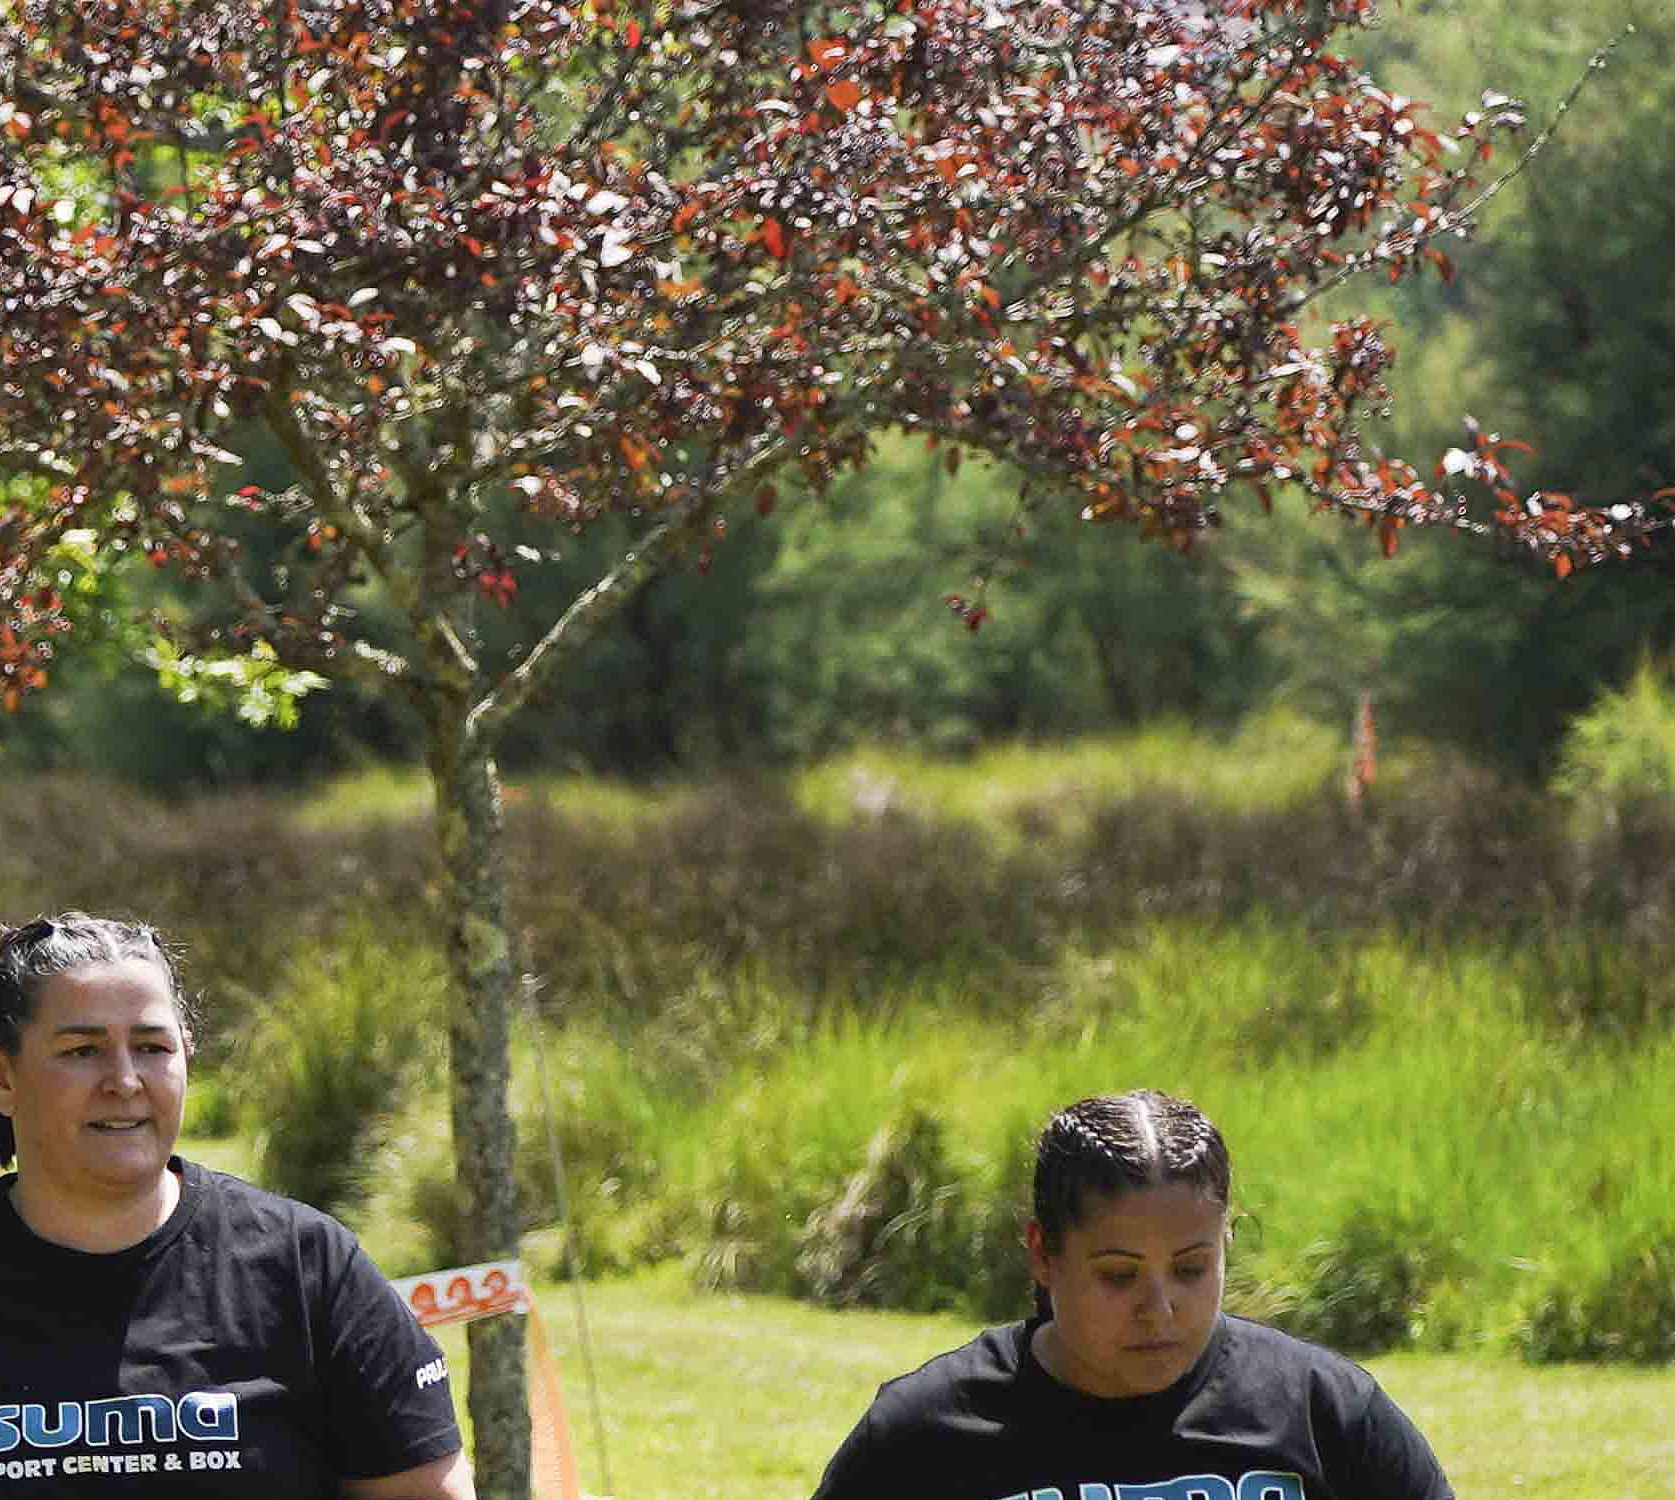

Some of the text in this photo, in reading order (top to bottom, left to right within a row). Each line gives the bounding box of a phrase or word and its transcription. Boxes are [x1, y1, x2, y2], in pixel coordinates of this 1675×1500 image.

[61, 1452, 158, 1476] CENTER
[163, 1452, 183, 1473] &
[189, 1449, 243, 1472] BOX
